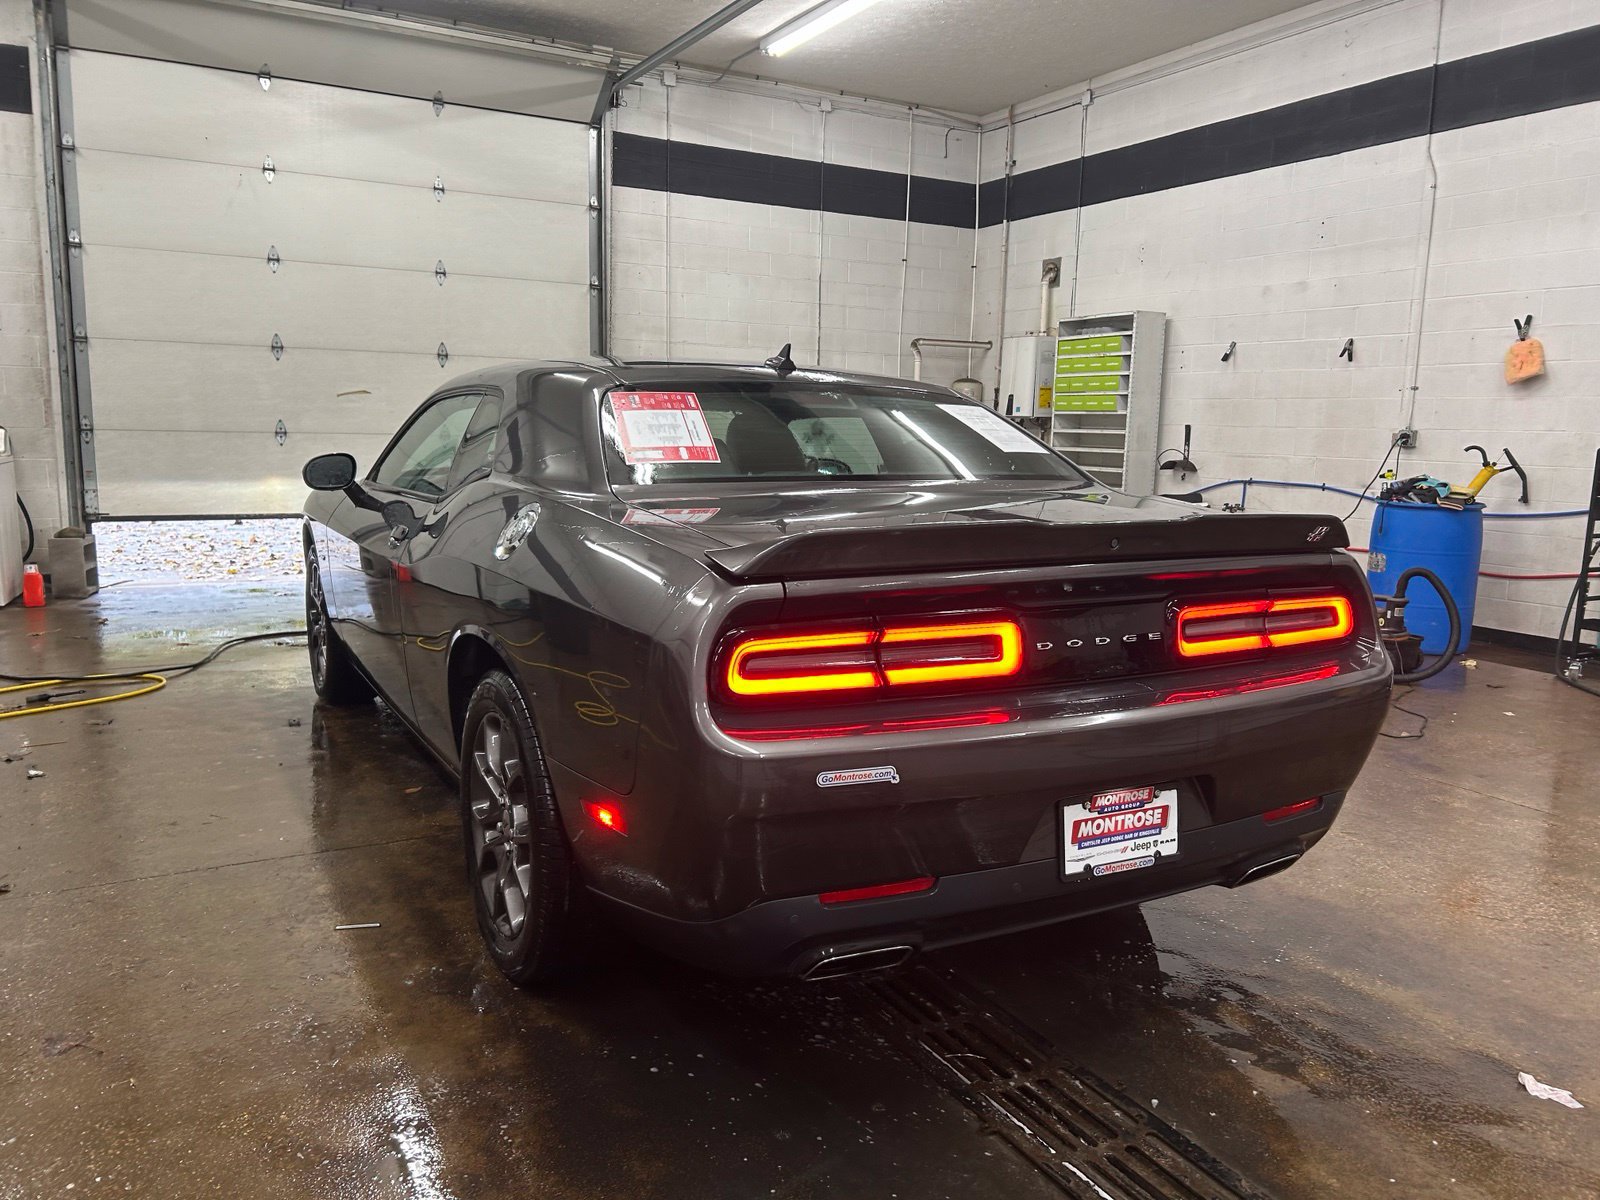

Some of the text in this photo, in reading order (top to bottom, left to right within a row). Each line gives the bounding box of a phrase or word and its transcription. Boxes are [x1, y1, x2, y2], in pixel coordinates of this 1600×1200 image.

[1037, 632, 1162, 650] DODGE
[822, 770, 892, 783] GoMontrose.com
[1095, 789, 1149, 806] MONTROSE
[1121, 802, 1140, 810] GROUP
[1078, 808, 1162, 837] MONTROSE
[1131, 841, 1151, 852] Jeep
[1095, 858, 1153, 874] GoMontrose.com
